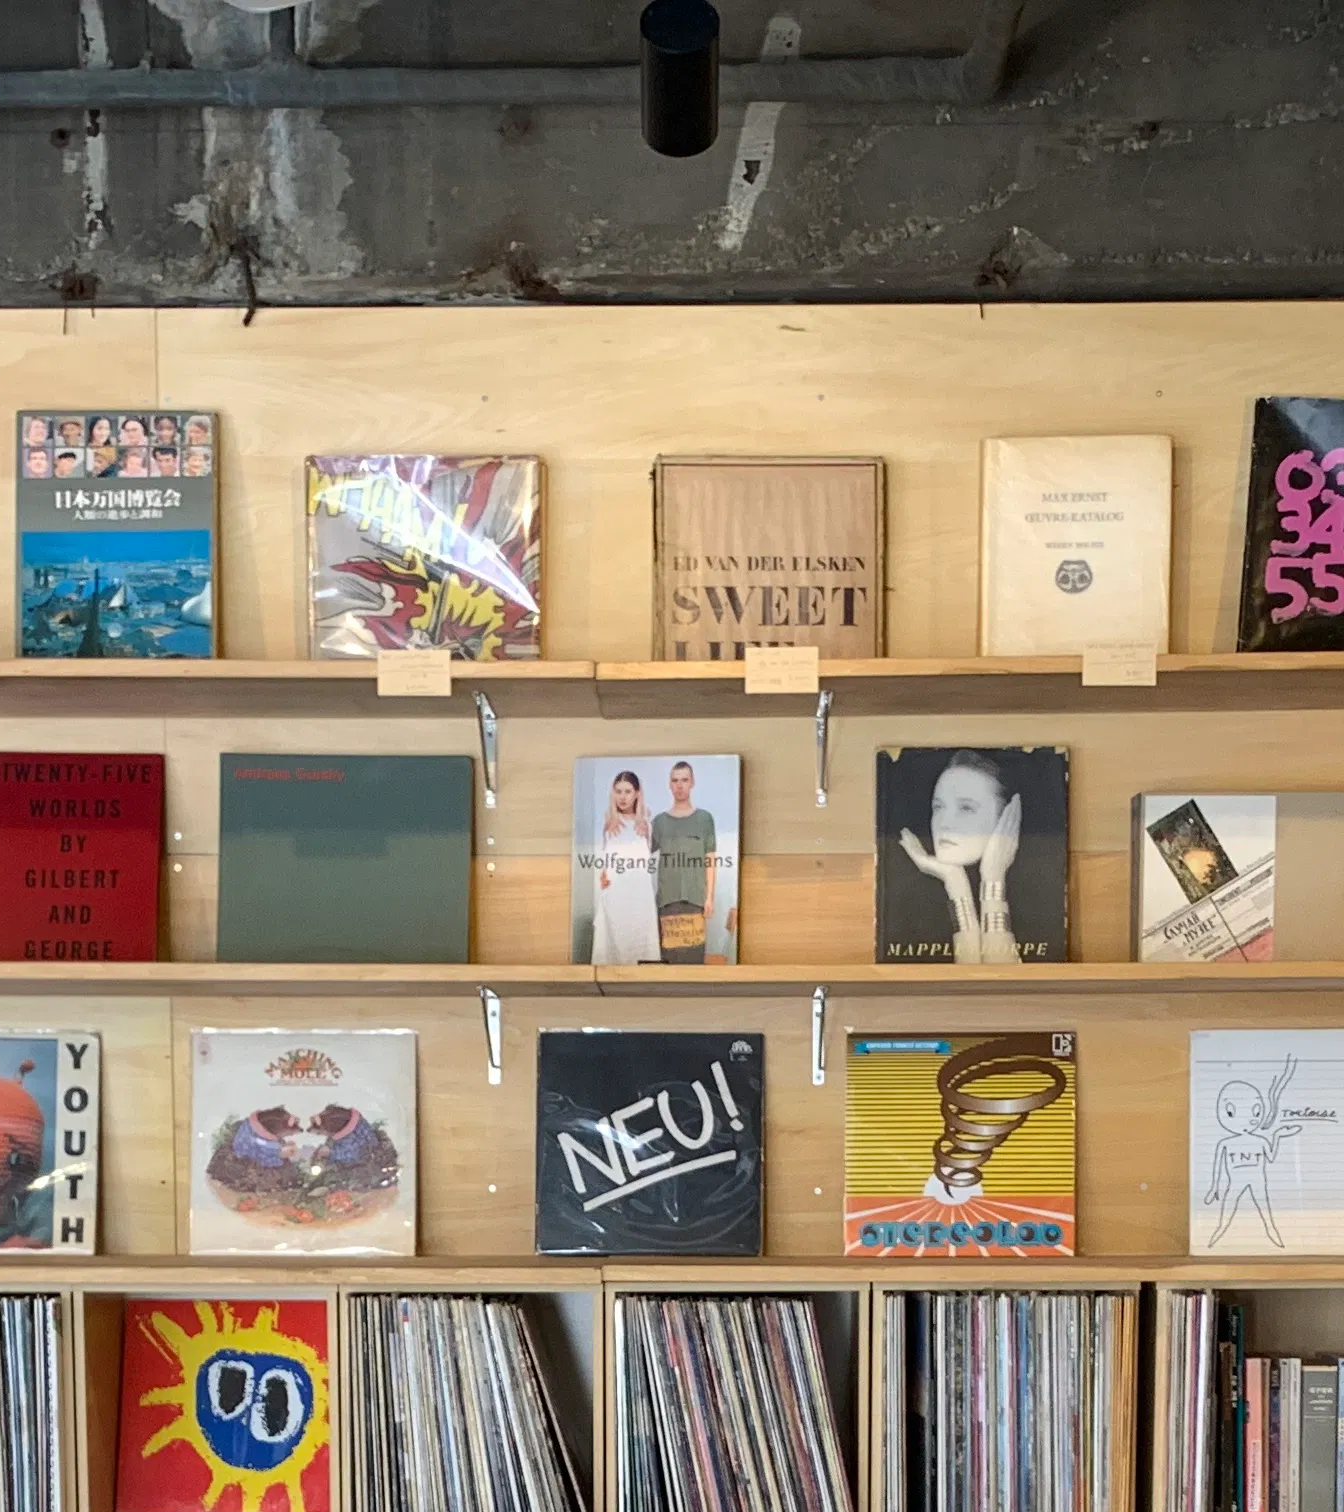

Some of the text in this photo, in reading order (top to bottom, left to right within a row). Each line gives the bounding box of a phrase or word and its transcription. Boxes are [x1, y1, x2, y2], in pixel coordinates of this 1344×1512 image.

[55, 488, 182, 509] 日本万国博覧会
[673, 556, 866, 572] ED VAN DER ELSKEN
[671, 585, 868, 627] SWEET
[1, 763, 153, 783] TWENTY-FIVE
[29, 799, 122, 818] WORLDS
[60, 834, 87, 853] BY
[578, 851, 734, 874] Wolfgang Tillmans
[24, 868, 121, 889] GILBERT
[48, 904, 93, 925] AND
[23, 939, 114, 961] GEORGE
[556, 1060, 745, 1194] NEU!
[60, 1043, 90, 1244] YOUTH
[1228, 1151, 1263, 1163] TNT
